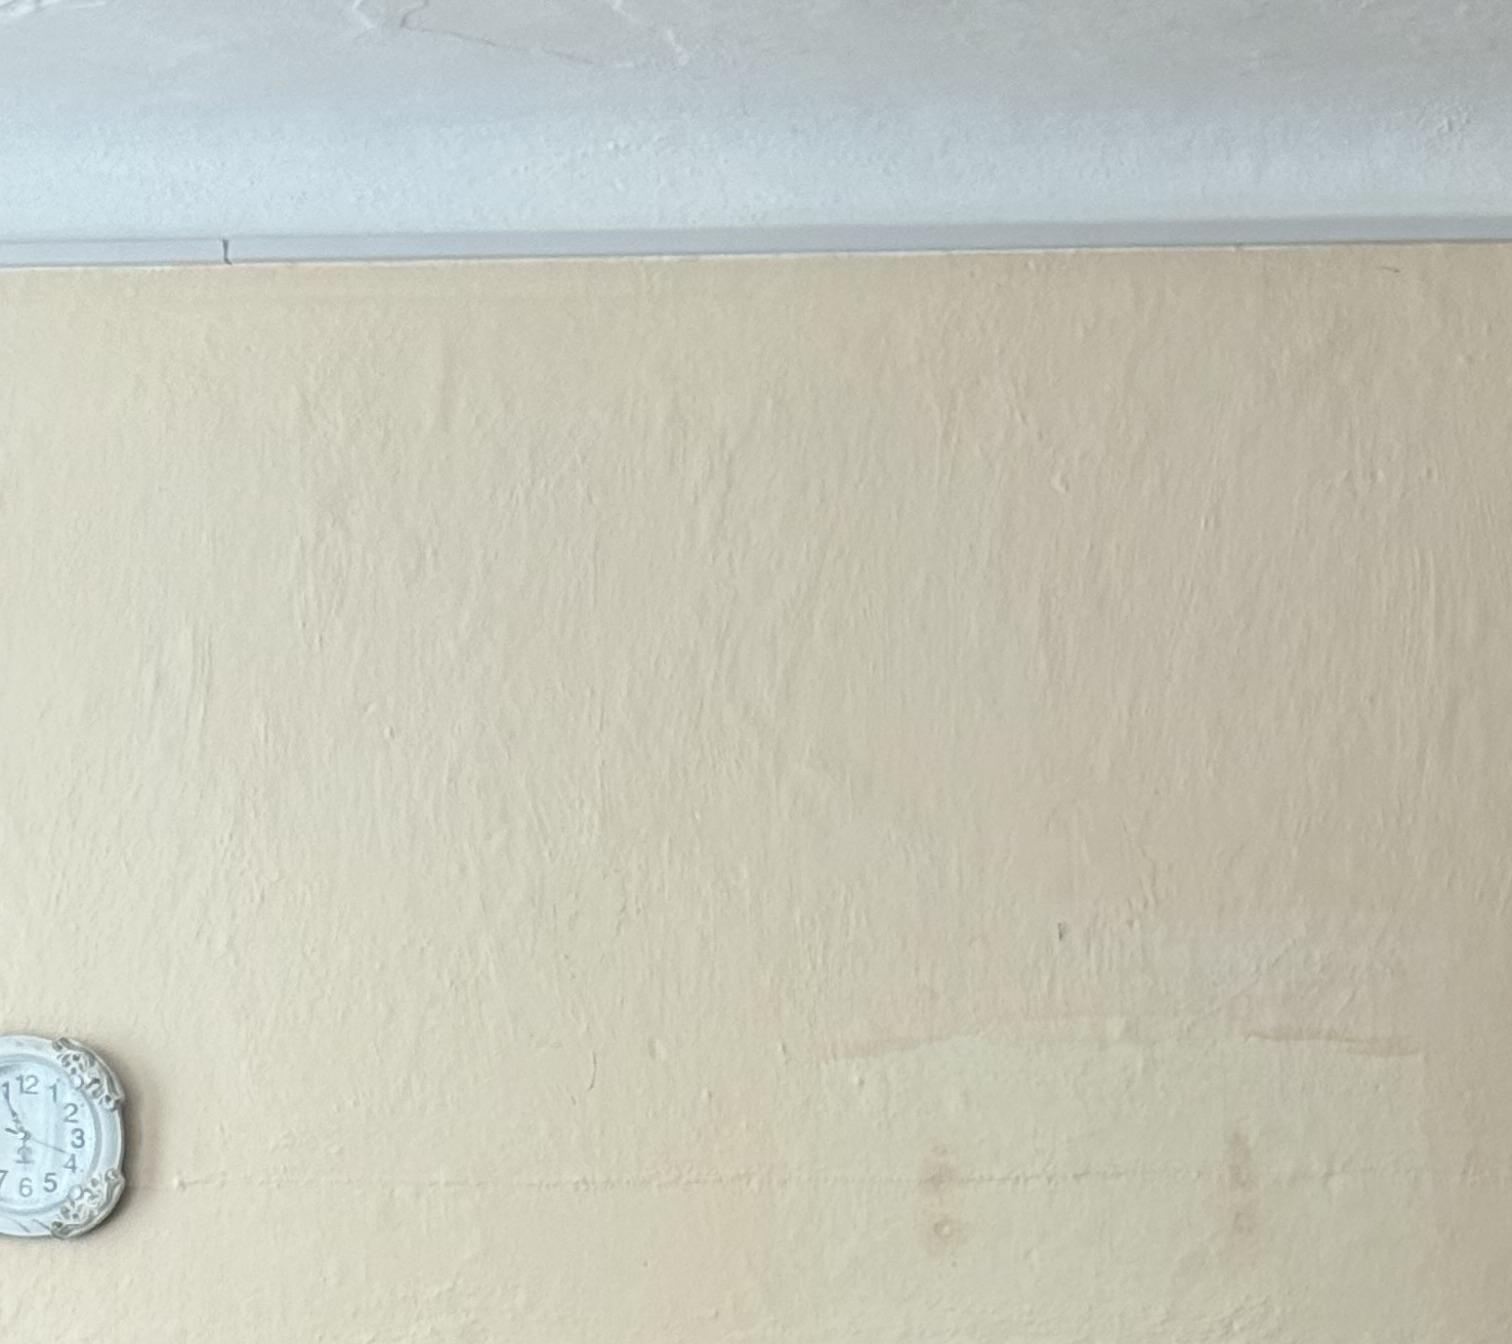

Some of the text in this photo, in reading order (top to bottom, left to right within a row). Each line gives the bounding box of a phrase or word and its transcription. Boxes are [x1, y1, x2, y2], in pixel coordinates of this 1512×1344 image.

[16, 1074, 38, 1095] 12
[49, 1083, 57, 1104] 1
[64, 1103, 78, 1123] 2
[71, 1128, 85, 1149] 3
[64, 1153, 78, 1173] 4
[19, 1177, 33, 1198] 6
[43, 1172, 57, 1193] 5
